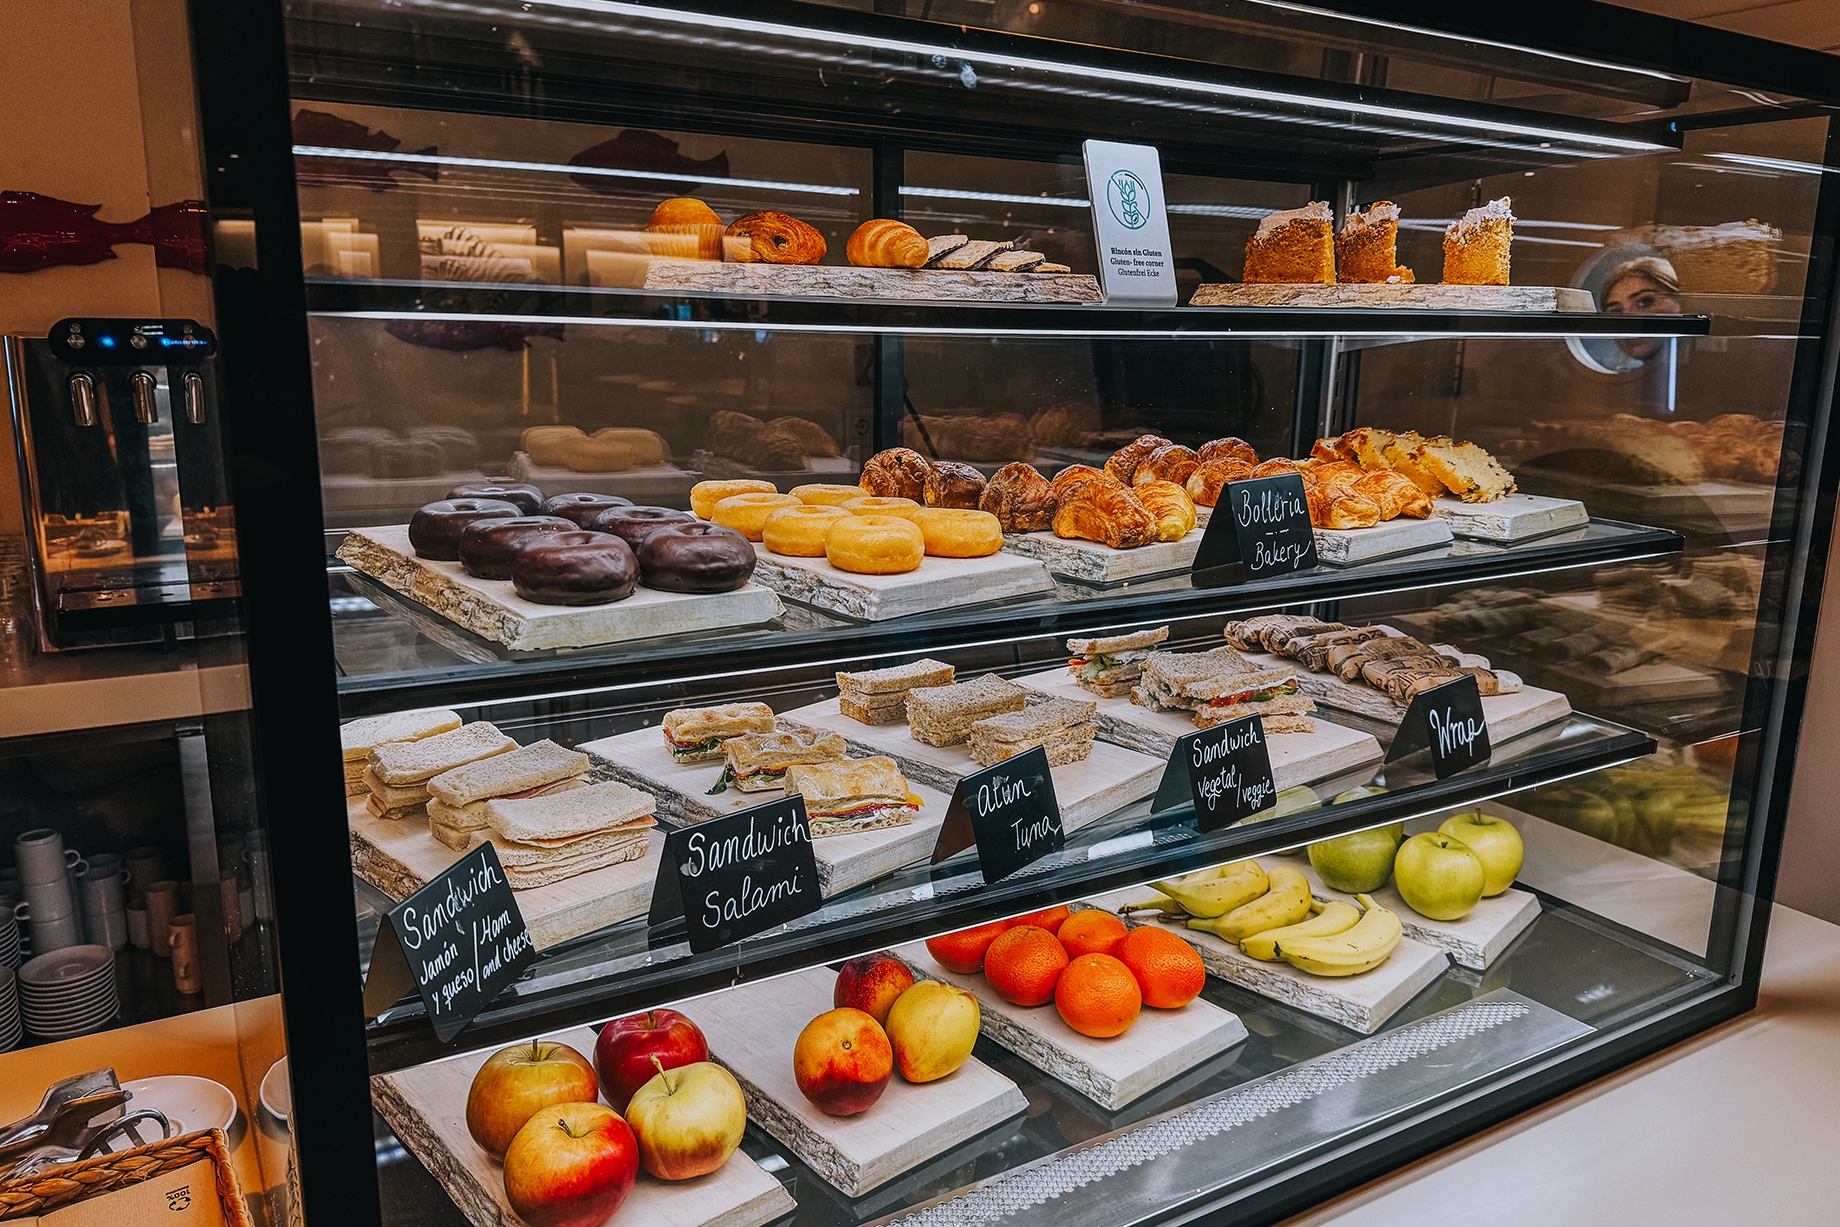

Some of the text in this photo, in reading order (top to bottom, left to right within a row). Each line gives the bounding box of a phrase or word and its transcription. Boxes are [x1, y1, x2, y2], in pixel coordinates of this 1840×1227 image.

[1110, 247, 1162, 257] Rincón sin Gluten
[1117, 268, 1160, 277] Glutenfrei Ecke
[1133, 258, 1145, 266] free
[1251, 540, 1311, 570] Bakery
[1193, 721, 1261, 768] Sandwich
[1429, 706, 1485, 759] Wrap
[688, 809, 812, 877] Sandwich
[1010, 816, 1061, 850] Tuna
[403, 852, 502, 949] Sandwich
[702, 866, 802, 928] Salami
[420, 941, 458, 985] Jamón
[480, 910, 512, 945] Ham
[442, 968, 474, 1011] queso
[483, 944, 501, 979] and
[503, 928, 533, 963] cheese
